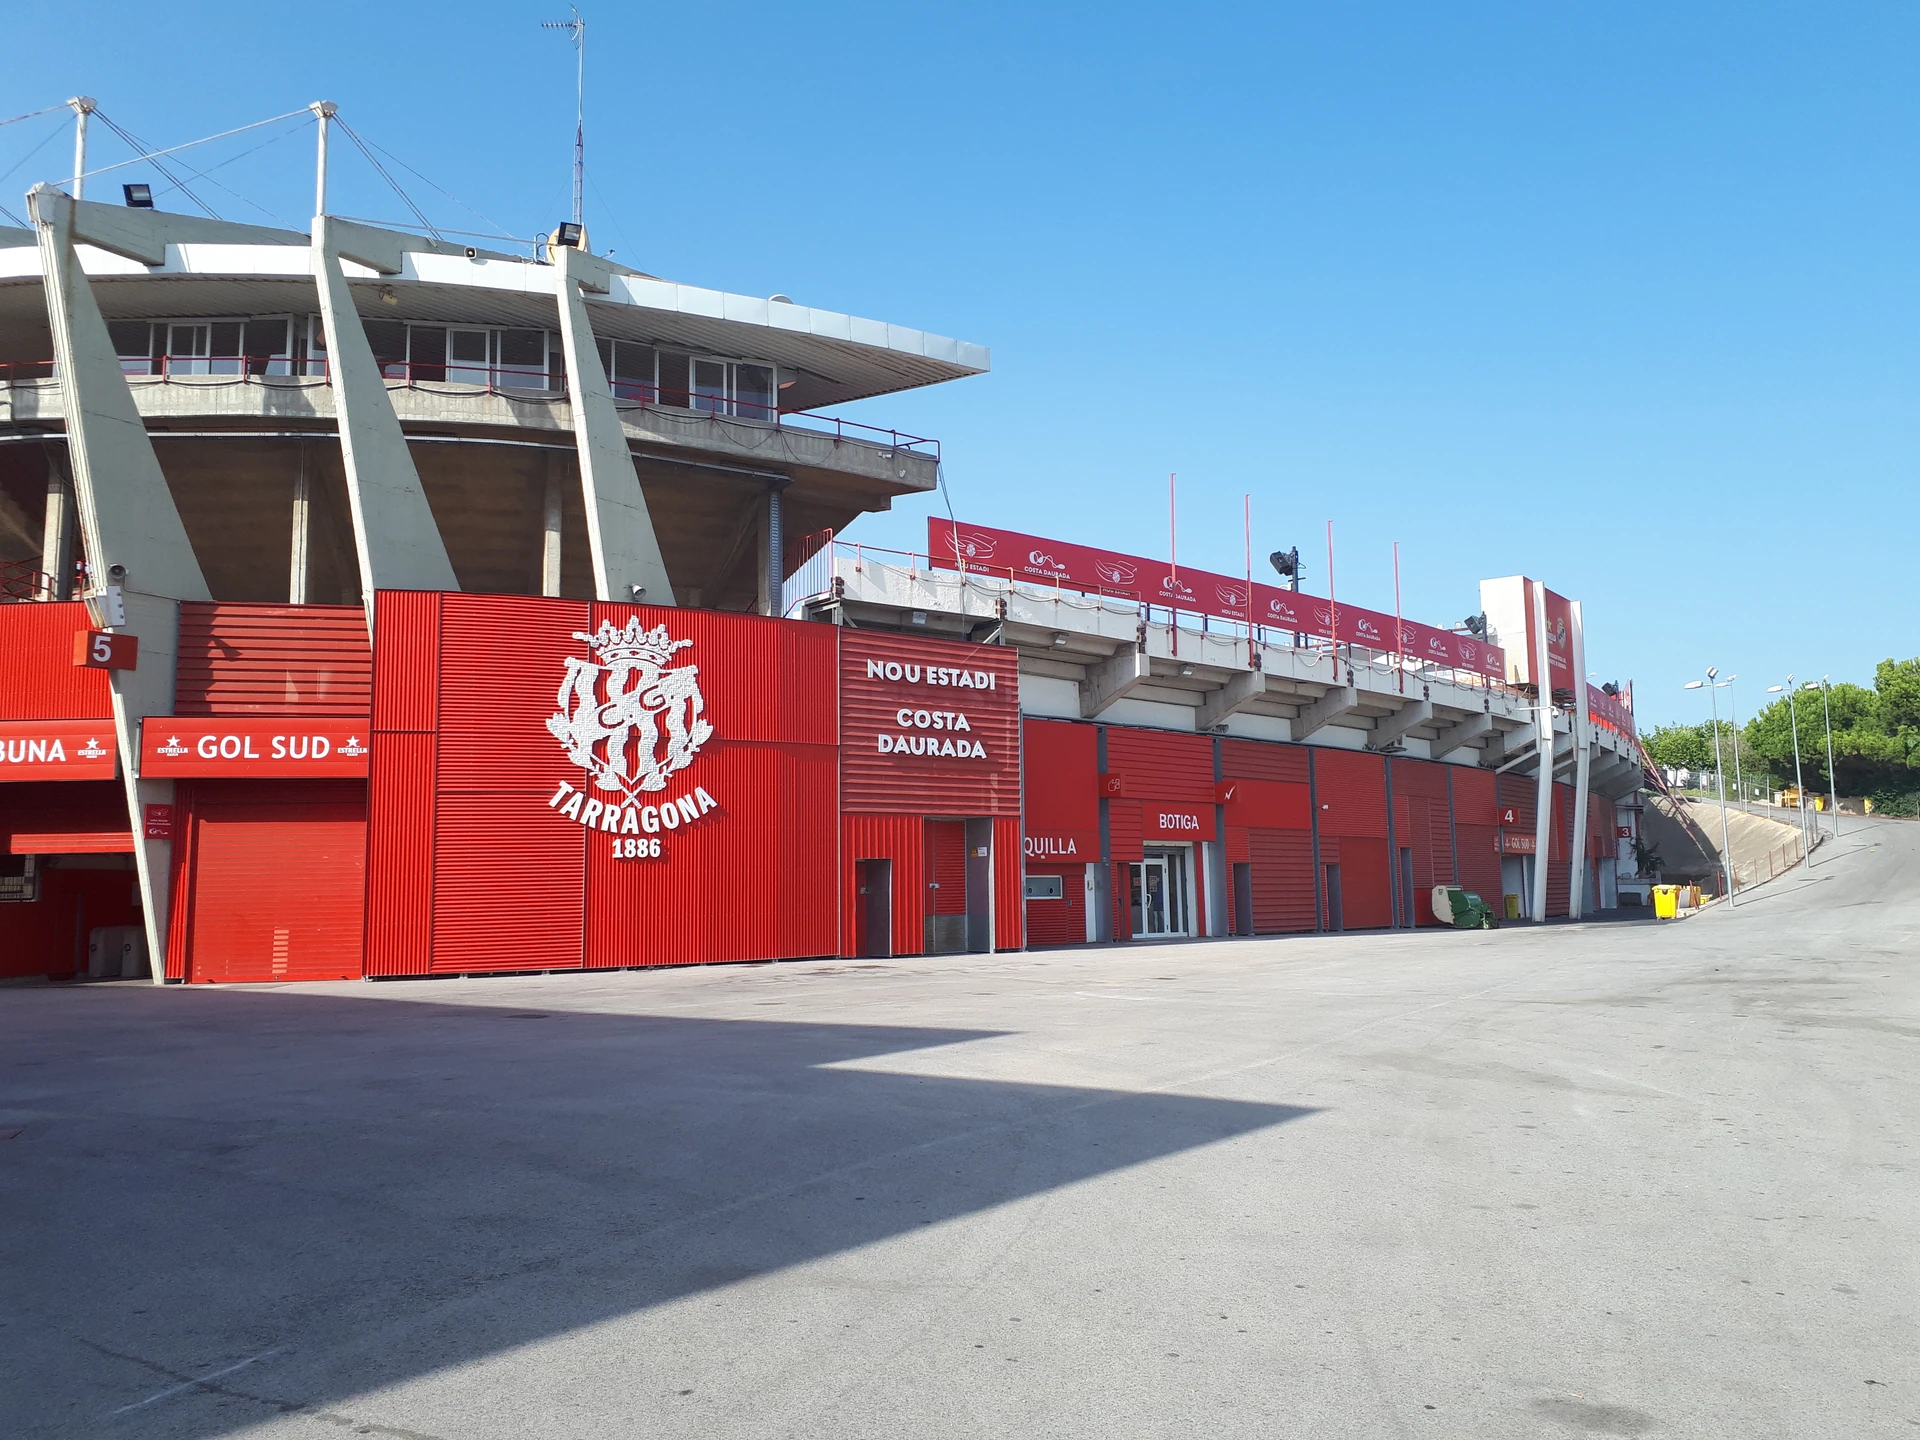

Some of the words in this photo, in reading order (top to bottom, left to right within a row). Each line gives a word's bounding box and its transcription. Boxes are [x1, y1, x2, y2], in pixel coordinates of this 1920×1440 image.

[954, 561, 969, 569] NU
[969, 563, 990, 573] ESTADI
[1024, 566, 1043, 575] COSTA
[1043, 569, 1071, 580] DAURADA
[1221, 608, 1231, 616] NOU
[92, 635, 112, 663] 5
[867, 658, 921, 684] NOU
[926, 665, 996, 691] ESTADI
[896, 708, 971, 732] COSTA
[198, 735, 260, 759] GOL
[271, 735, 330, 759] SUD
[878, 733, 987, 760] DAURADA
[548, 780, 718, 835] TARRAGONA
[1504, 809, 1514, 823] 4
[1159, 813, 1200, 830] BOTIGA
[1622, 827, 1630, 837] 3
[612, 838, 661, 859] 1886
[1024, 837, 1077, 857] QUILLA
[1511, 837, 1521, 849] GOL
